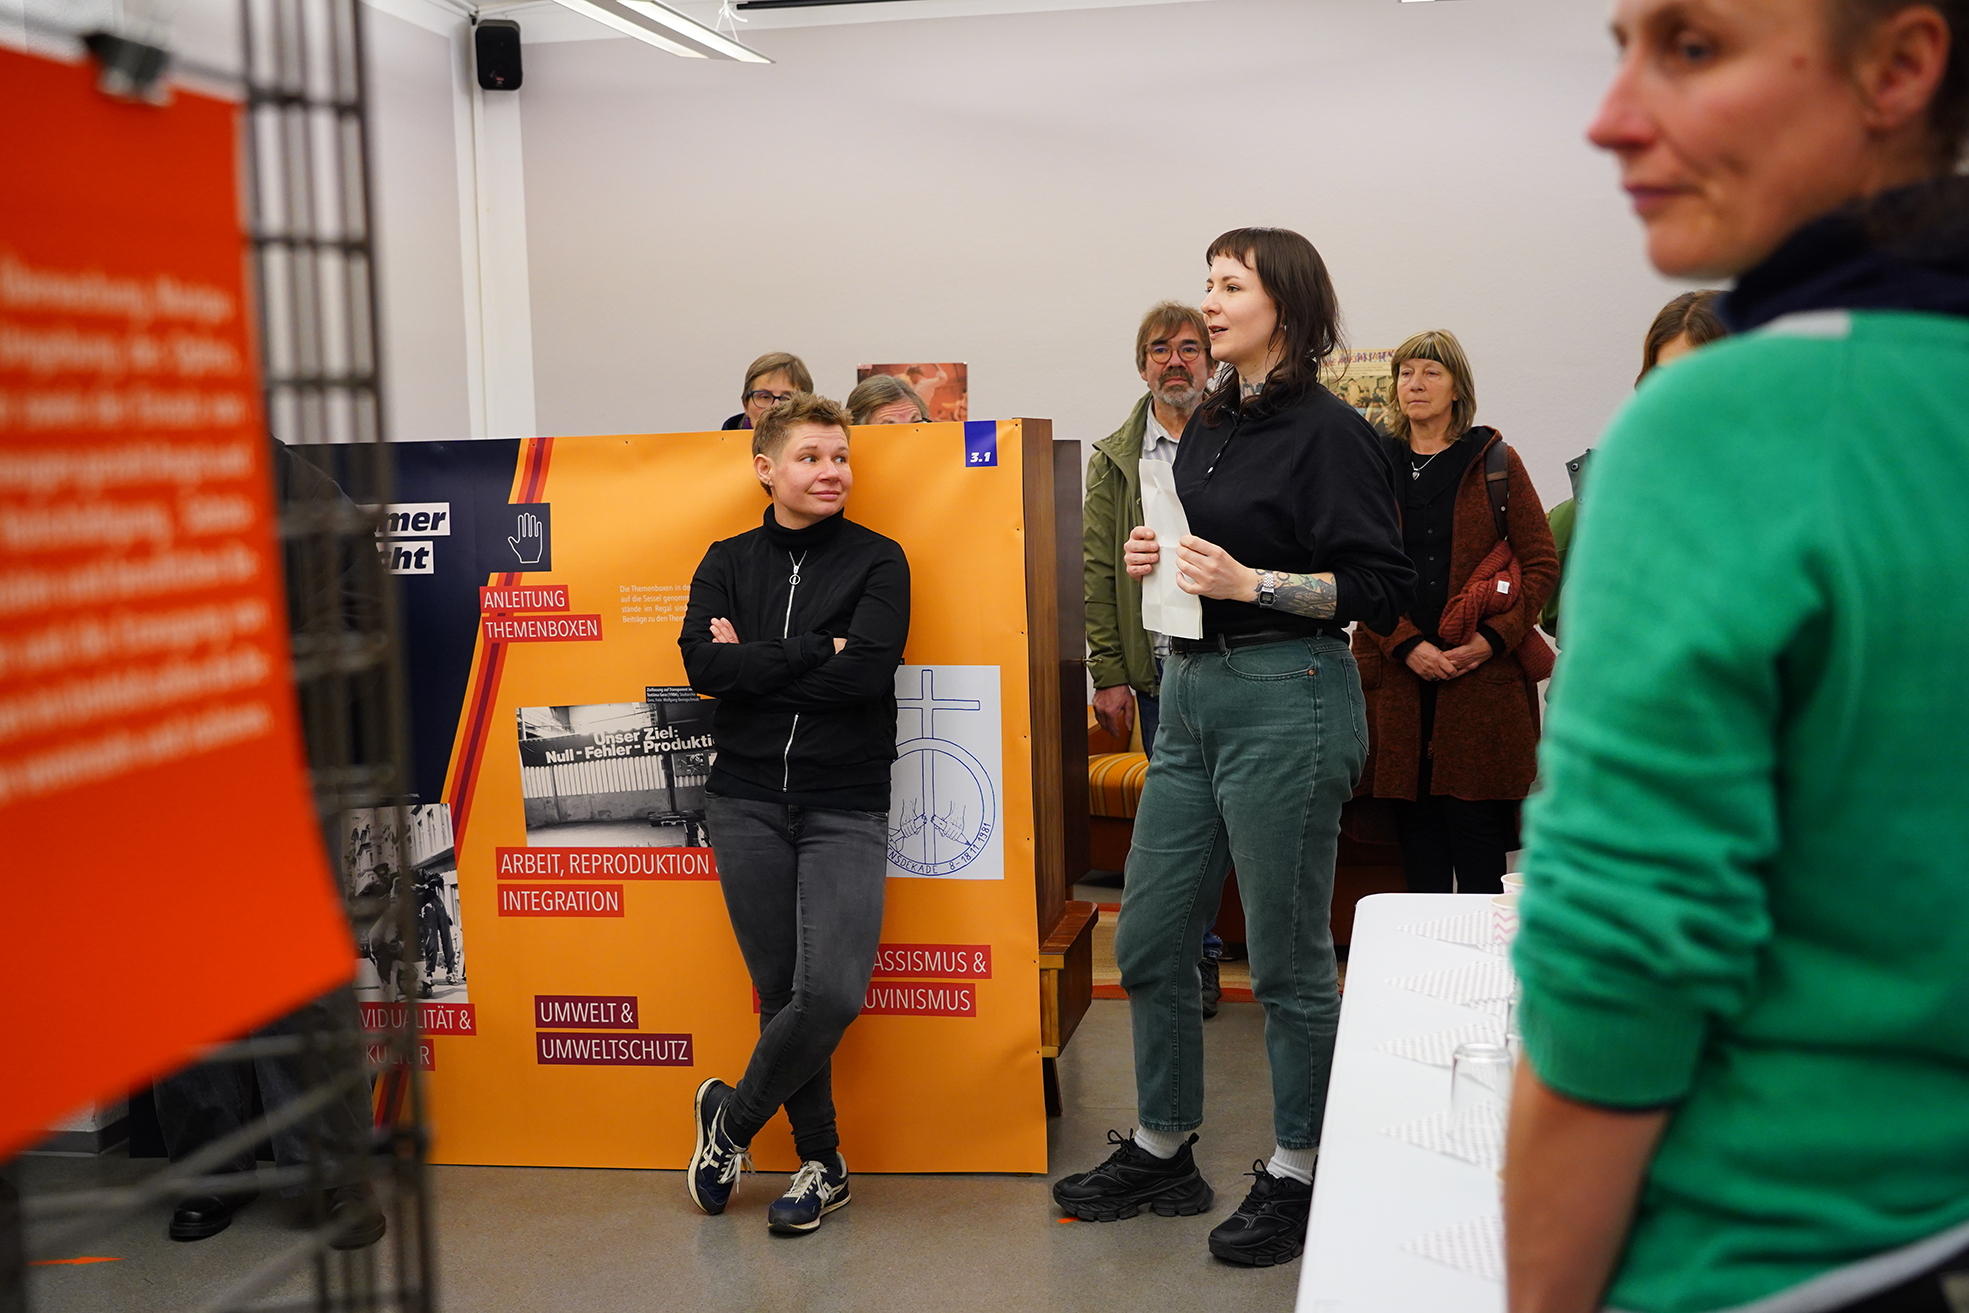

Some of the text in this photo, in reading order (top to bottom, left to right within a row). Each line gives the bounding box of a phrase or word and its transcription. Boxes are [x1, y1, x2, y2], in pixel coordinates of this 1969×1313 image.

[969, 451, 991, 463] 3.1
[631, 584, 673, 592] Themenboxen
[643, 594, 662, 602] Sessel
[484, 590, 565, 609] ANLEITUNG
[622, 605, 641, 613] stände
[655, 604, 672, 614] Regal
[485, 619, 598, 638] THEMENBOXEN
[622, 615, 647, 625] Beiträge
[593, 725, 679, 746] Unser Ziel:
[545, 748, 575, 764] Null
[585, 743, 633, 759] Fehler
[643, 734, 715, 754] Produkti
[501, 853, 710, 877] ARBEIT, REPRODUKTION
[503, 890, 619, 912] INTEGRATION
[873, 950, 987, 973] ASSISMUS &
[862, 988, 971, 1011] UVINISMUS
[459, 1009, 472, 1030] &
[540, 1002, 634, 1024] UMWELT &
[542, 1039, 688, 1061] UMWELTSCHUTZ
